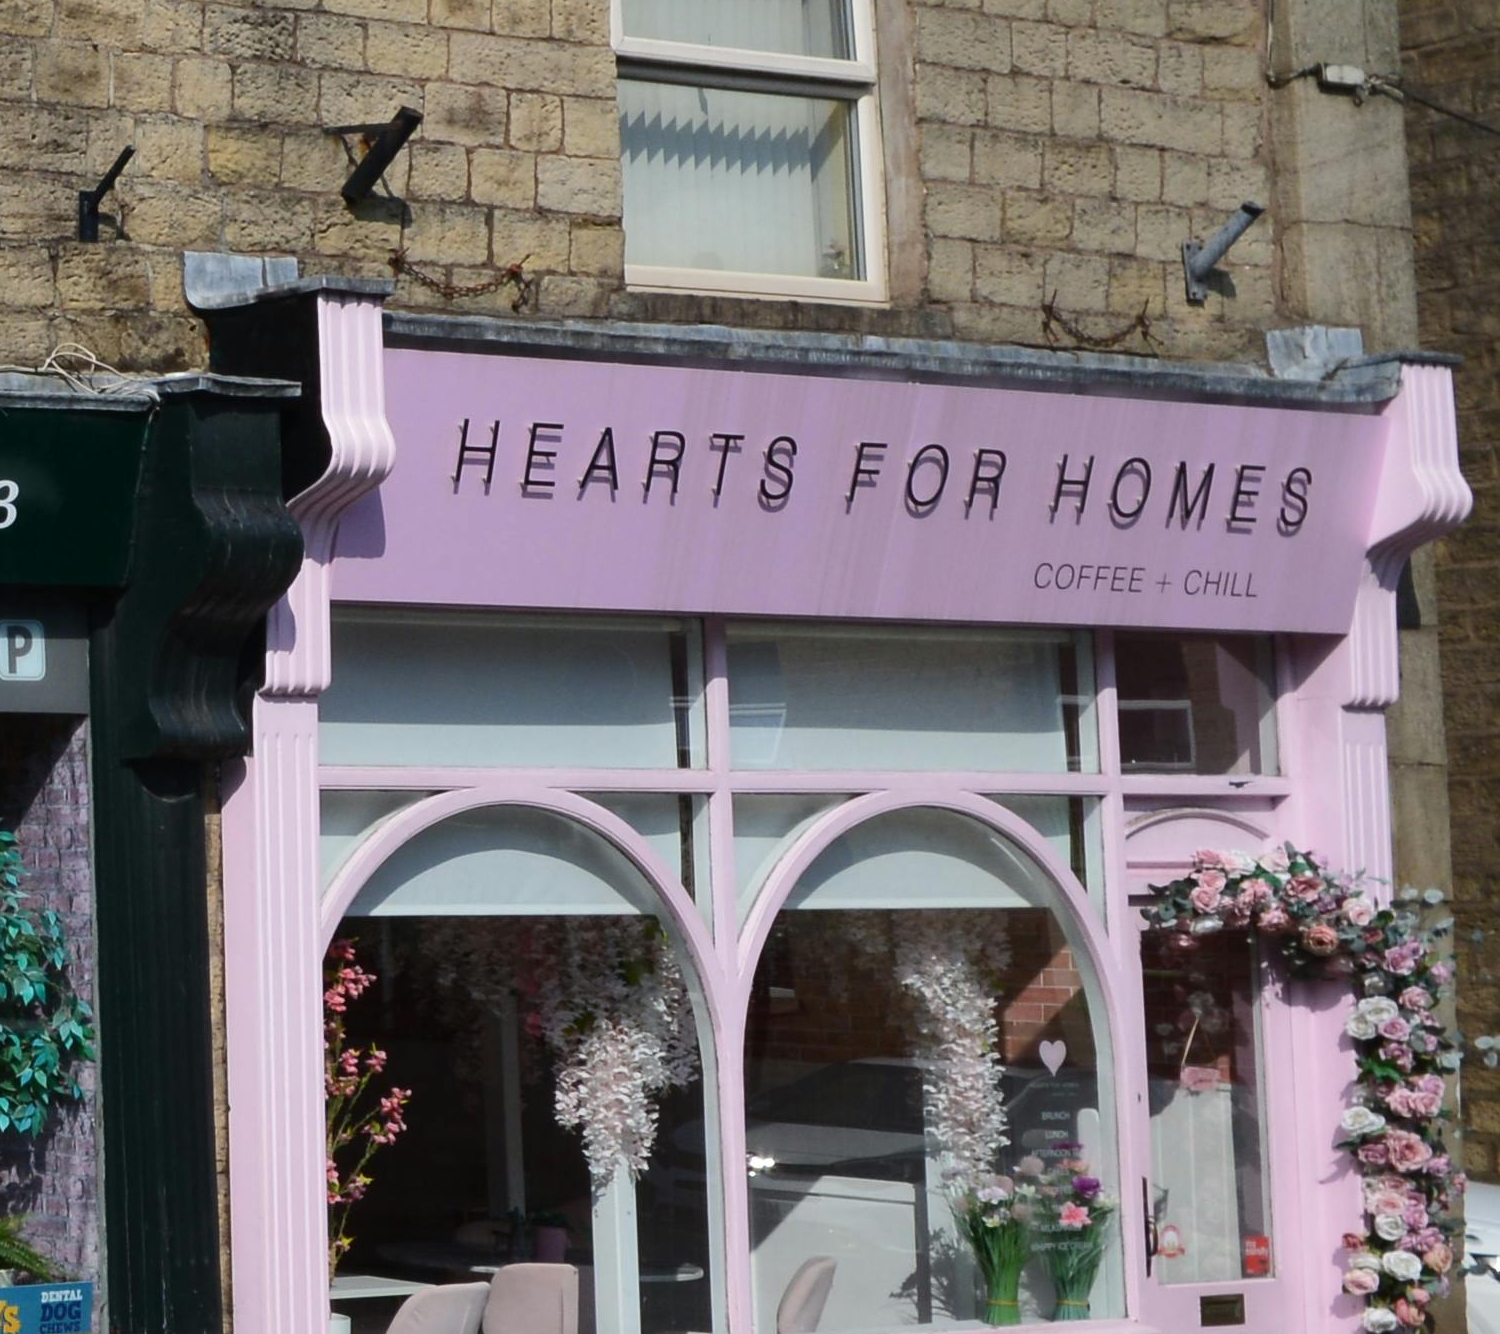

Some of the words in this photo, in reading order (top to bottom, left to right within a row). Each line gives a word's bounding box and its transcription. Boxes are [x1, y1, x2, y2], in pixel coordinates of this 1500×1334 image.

[451, 418, 799, 503] HEARTS
[848, 441, 1009, 511] FOR
[1051, 453, 1314, 531] HOMES
[1034, 562, 1145, 593] COFFEE
[1184, 570, 1258, 598] CHILL
[1041, 1111, 1071, 1121] BRUNCH
[1044, 1130, 1069, 1140] LUNCH
[40, 1289, 83, 1304] DENTAL
[40, 1302, 82, 1323] DOG
[39, 1321, 82, 1334] CHEWS
